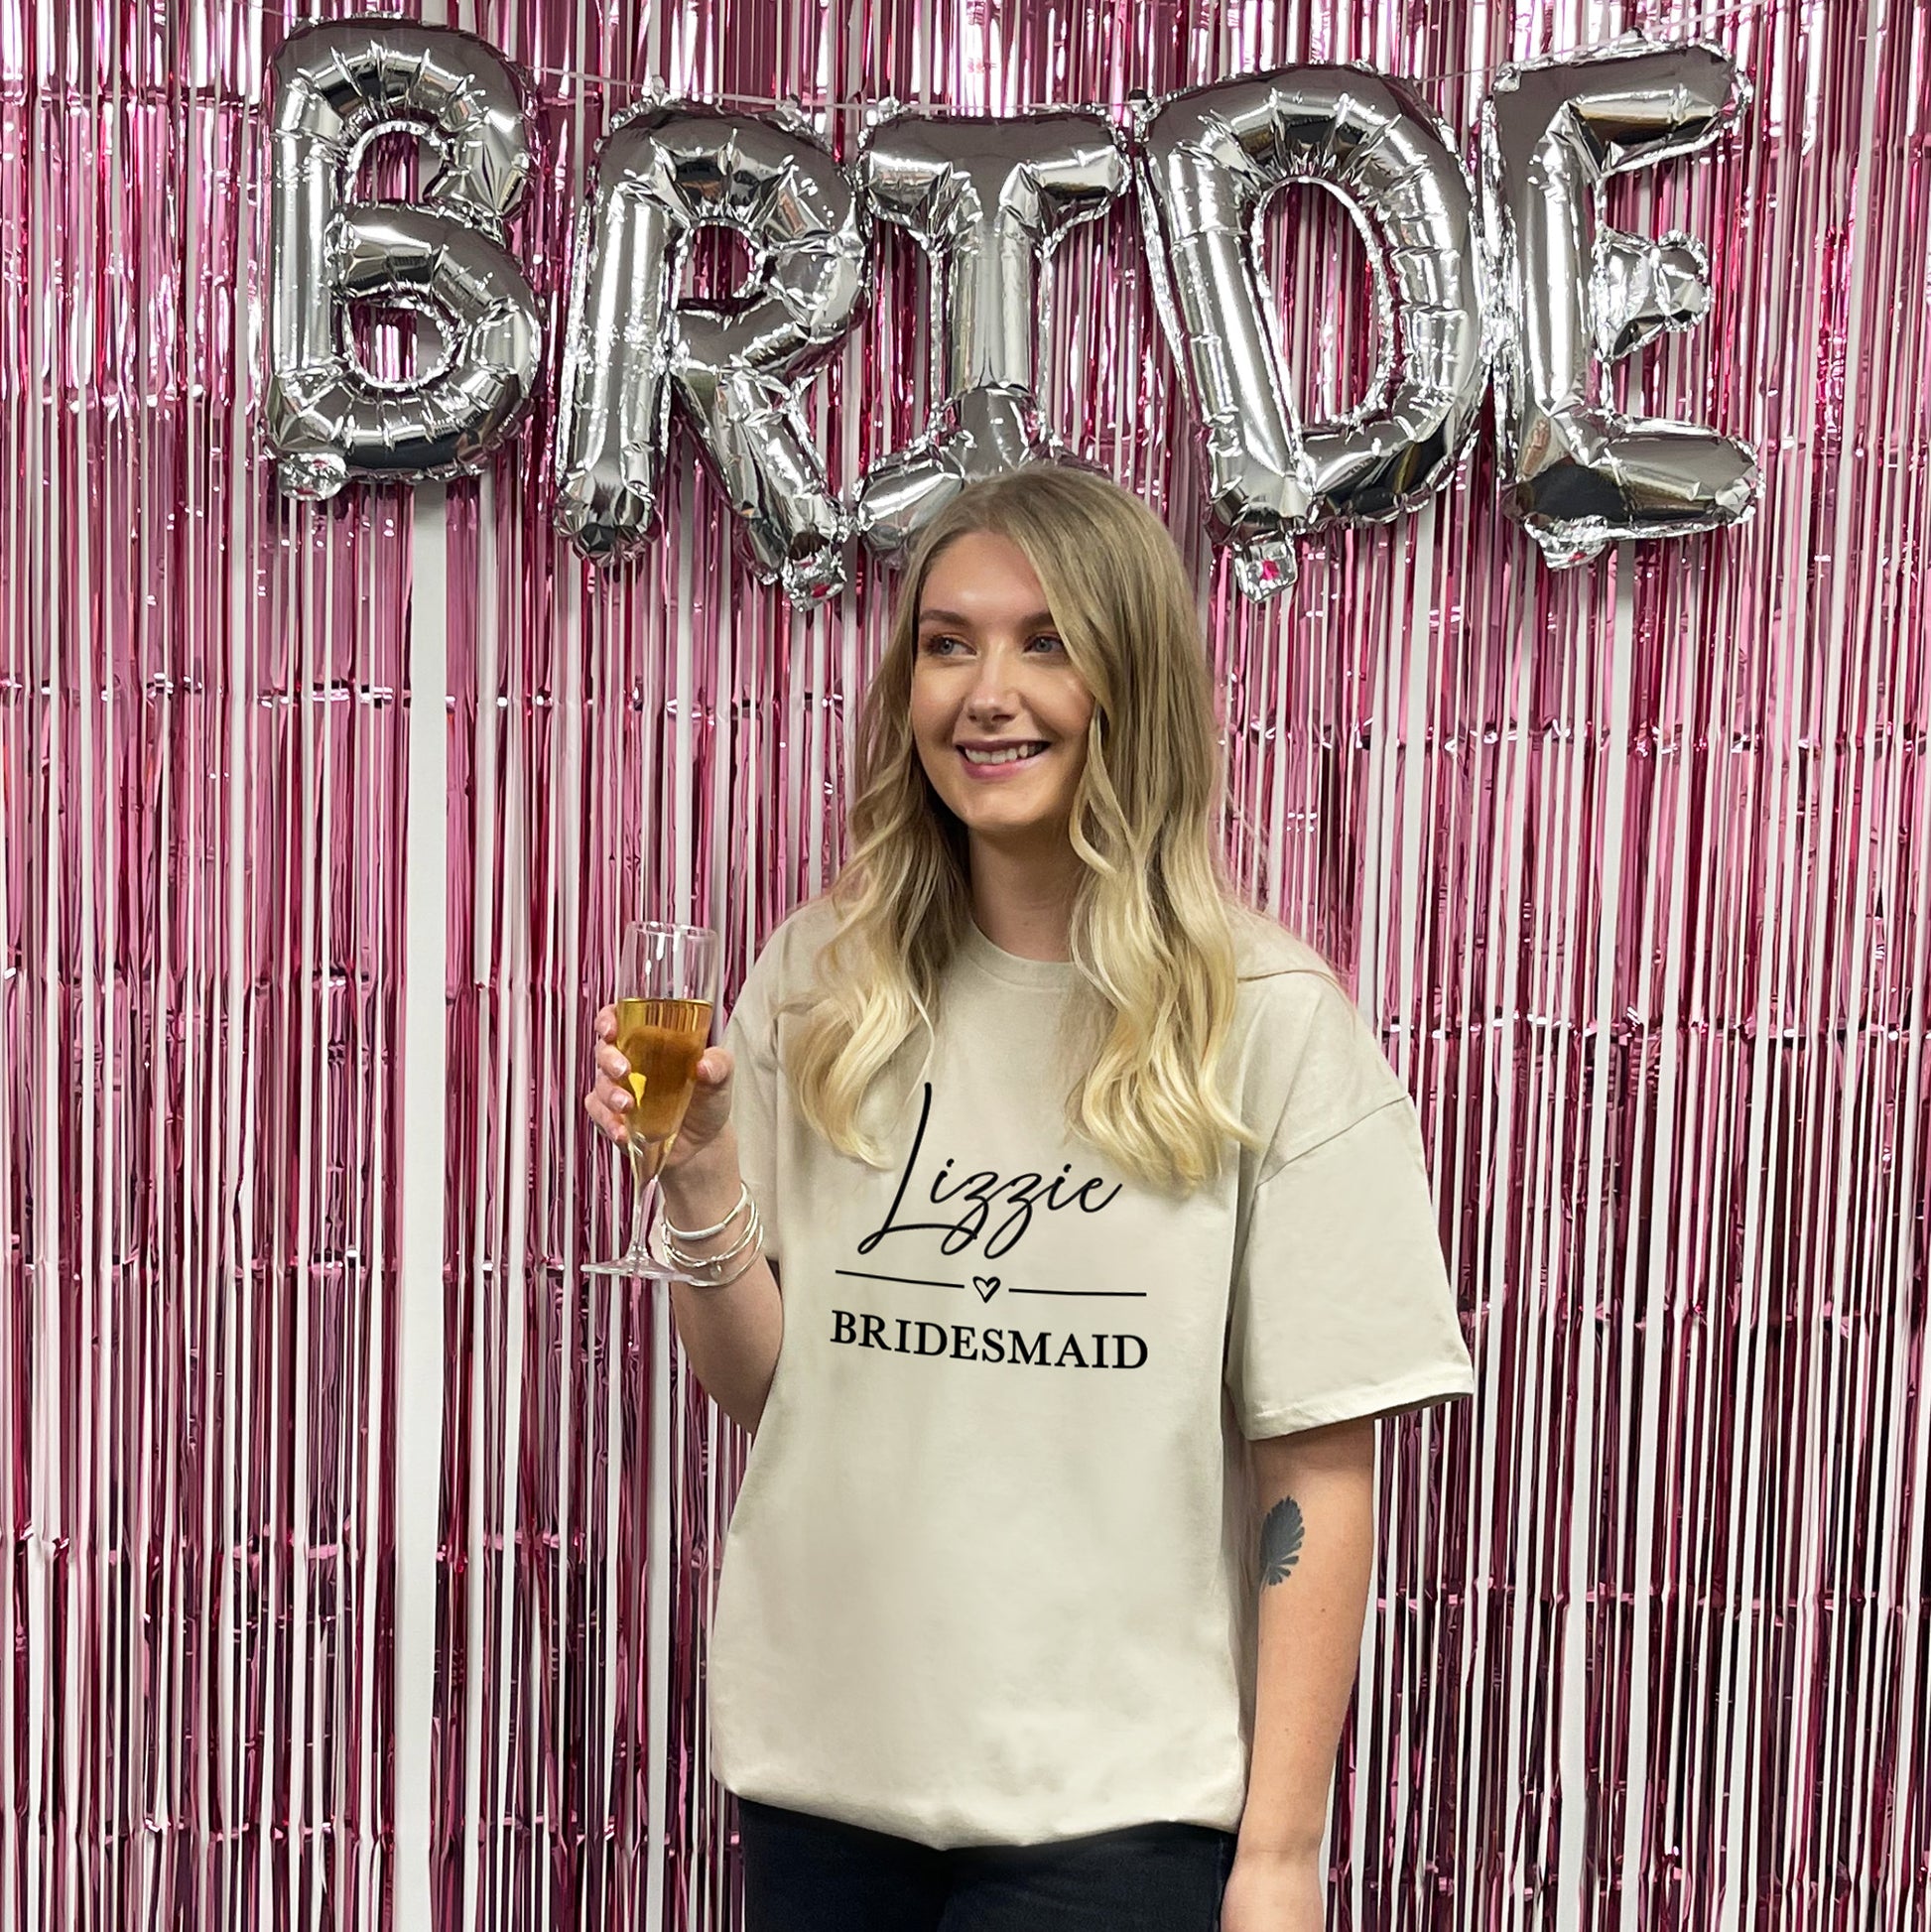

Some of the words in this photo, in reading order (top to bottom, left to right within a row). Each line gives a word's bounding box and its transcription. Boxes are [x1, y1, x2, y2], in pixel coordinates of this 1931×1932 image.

[263, 15, 1762, 607] BRIDE
[856, 1081, 1123, 1260] Lizzie
[830, 1309, 1149, 1369] BRIDESMAID
